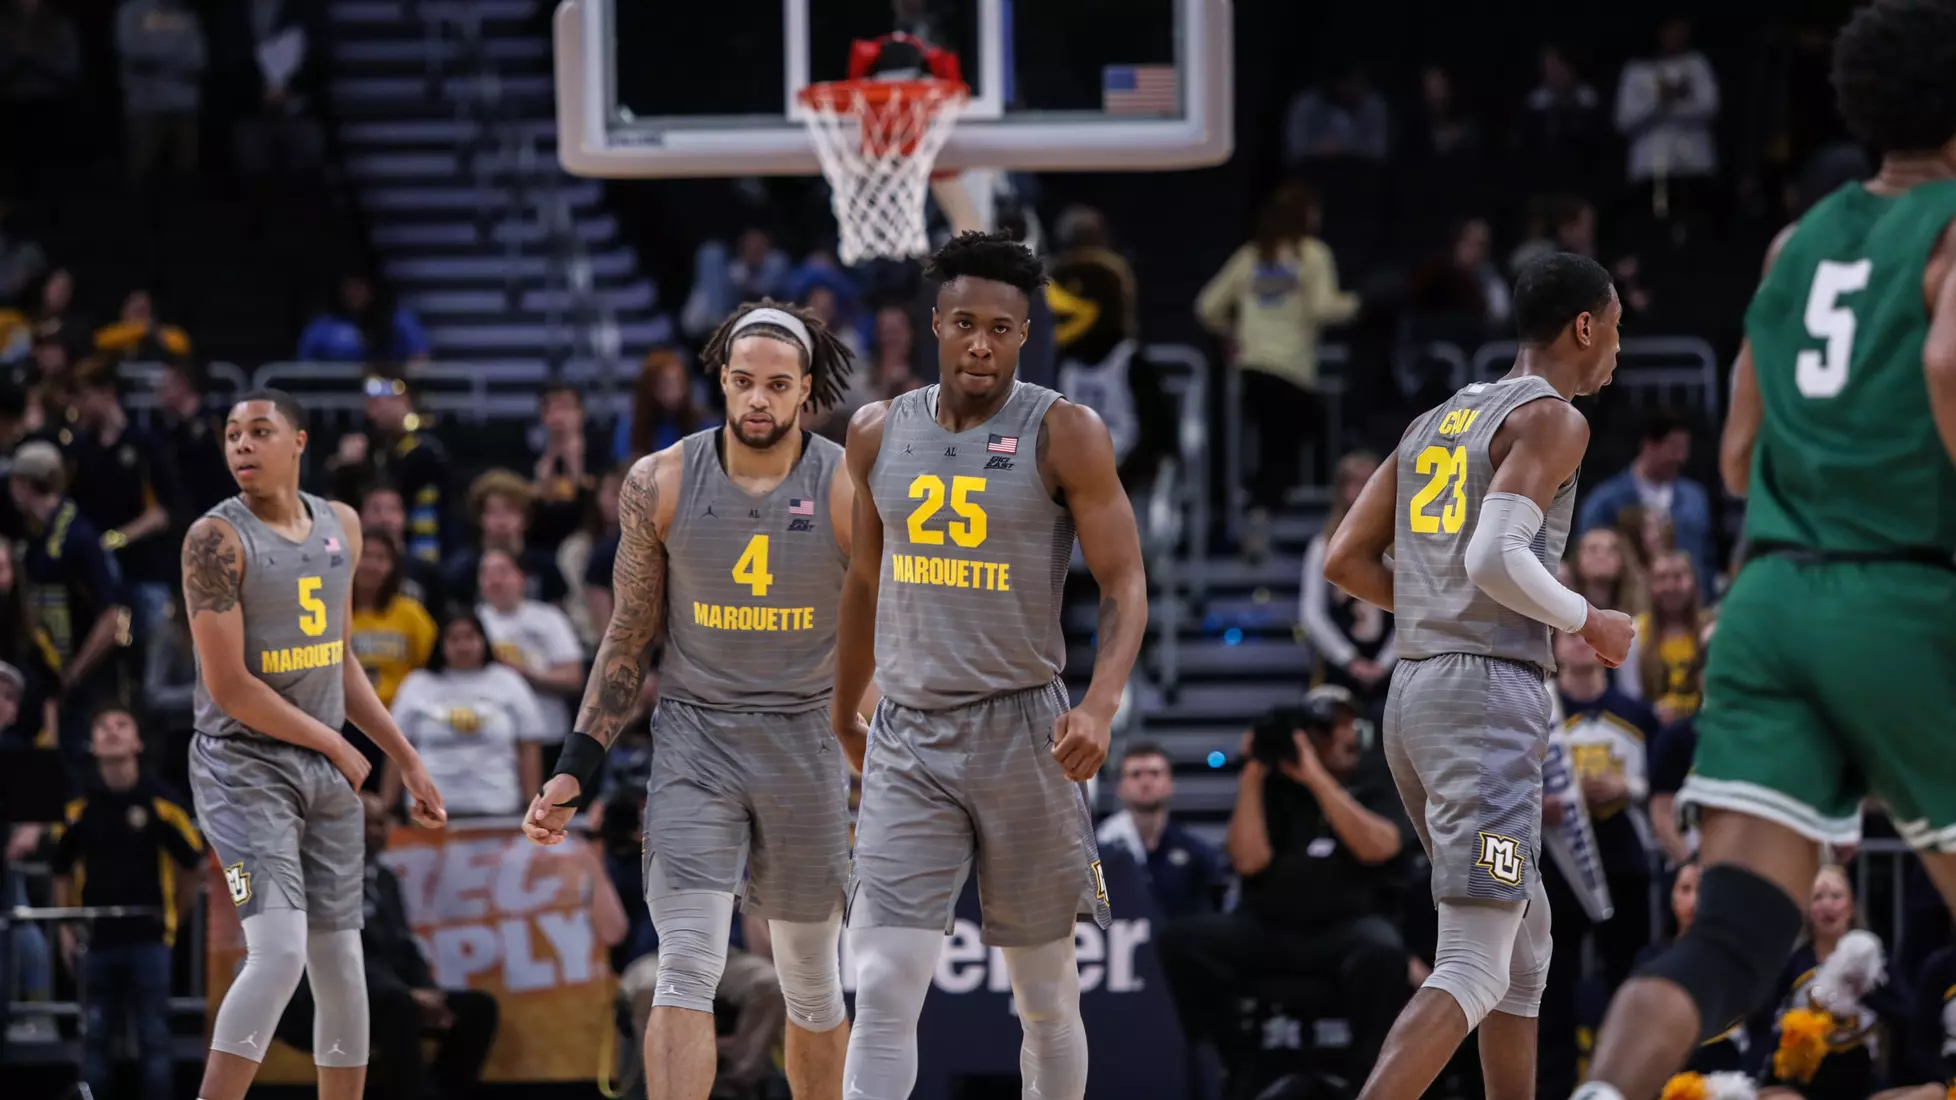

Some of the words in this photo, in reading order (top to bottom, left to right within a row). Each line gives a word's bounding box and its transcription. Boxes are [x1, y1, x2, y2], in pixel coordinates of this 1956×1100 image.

[1795, 258, 1873, 398] 5
[906, 474, 987, 548] 25
[1410, 445, 1467, 534] 23
[731, 533, 773, 596] 4
[892, 553, 1009, 591] MARQUETTE
[298, 576, 327, 636] 5
[693, 601, 814, 631] MARQUETTE
[1478, 833, 1524, 886] MU
